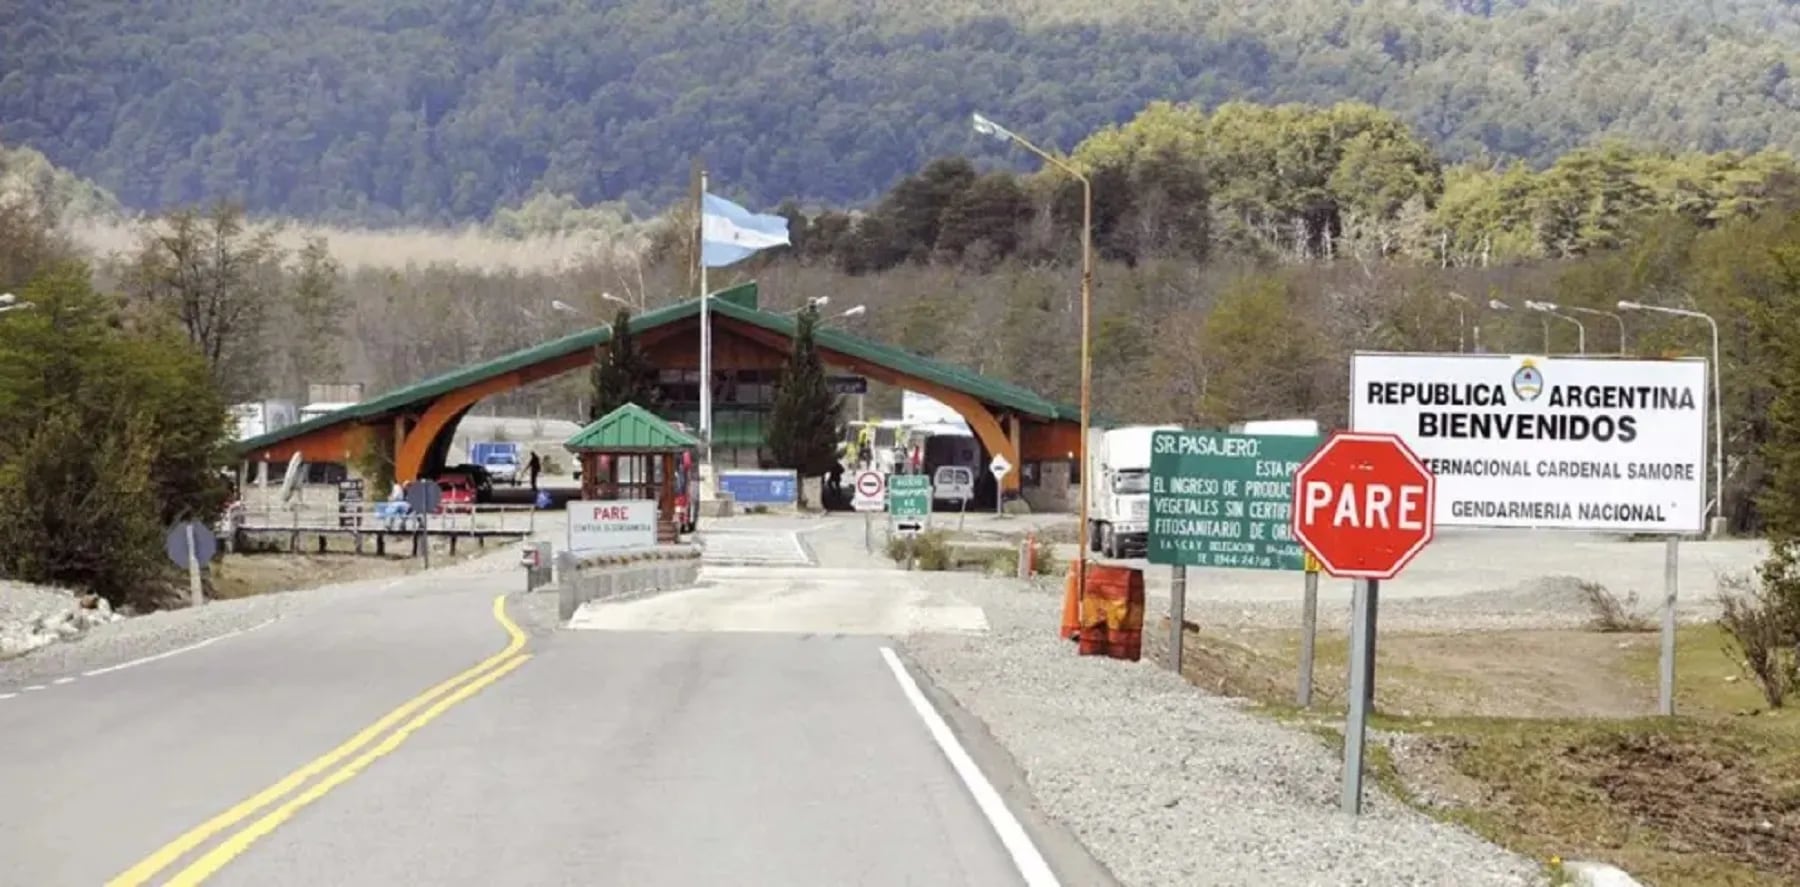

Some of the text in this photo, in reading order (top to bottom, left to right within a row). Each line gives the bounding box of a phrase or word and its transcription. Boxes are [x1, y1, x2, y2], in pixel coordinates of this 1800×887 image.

[1367, 381, 1695, 410] REPUBLICA ARGENTINA
[1418, 411, 1637, 443] BIENVENIDOS
[1255, 460, 1284, 477] ESTA
[1536, 460, 1622, 479] CARDENAL
[1627, 462, 1694, 480] SAMORE
[1153, 477, 1166, 493] EL
[1170, 477, 1219, 495] INGRESO
[1223, 479, 1238, 496] DE
[593, 505, 630, 521] PARE
[1154, 499, 1219, 516] VEGETALES
[1225, 501, 1244, 517] SIN
[1305, 481, 1424, 531] PARE
[1451, 501, 1666, 522] GENDARMERIA NACIONAL
[1154, 519, 1241, 539] FITOSANITARIO
[1250, 523, 1265, 539] DE
